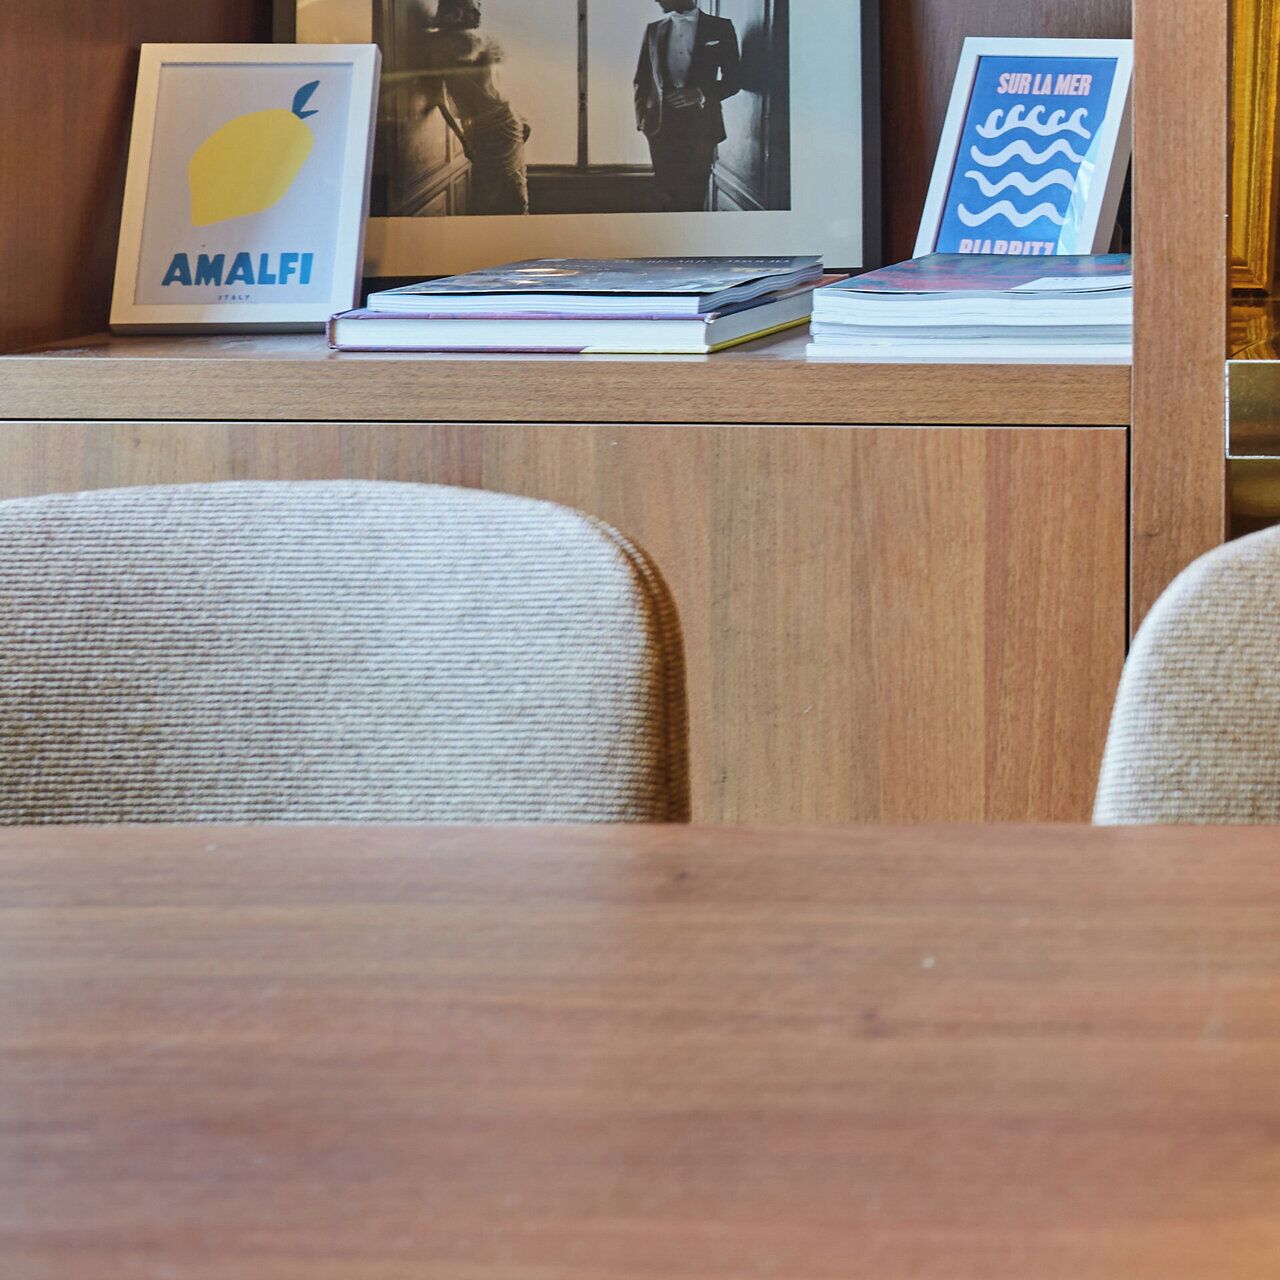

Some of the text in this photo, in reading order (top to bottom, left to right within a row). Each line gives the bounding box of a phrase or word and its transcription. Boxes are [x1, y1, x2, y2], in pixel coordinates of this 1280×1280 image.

[997, 73, 1093, 96] SUR LA MER
[161, 252, 314, 286] AMALFI
